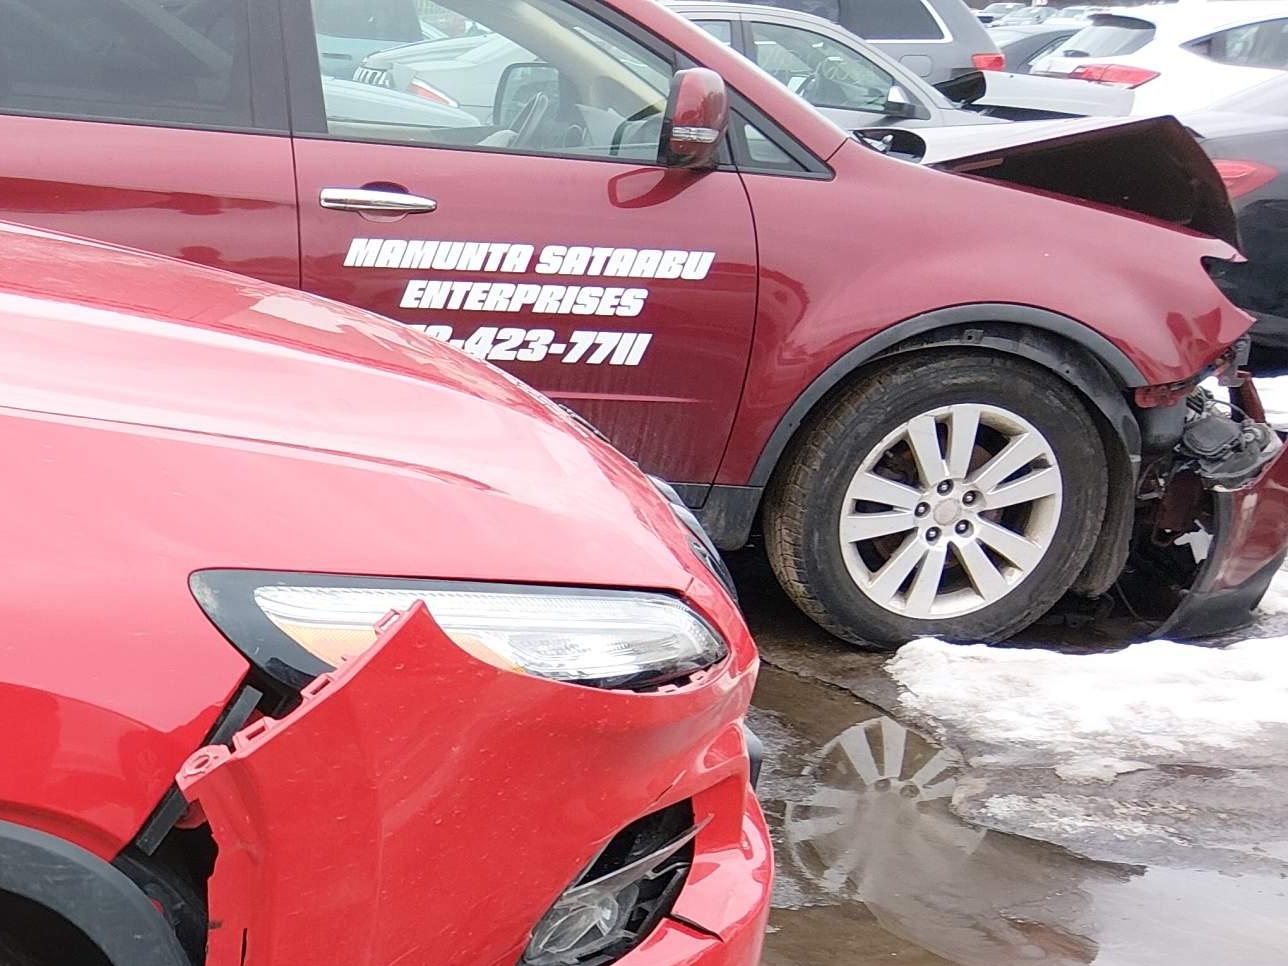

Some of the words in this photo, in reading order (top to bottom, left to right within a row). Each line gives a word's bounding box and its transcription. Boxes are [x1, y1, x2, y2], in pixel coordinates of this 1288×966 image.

[343, 238, 535, 273] MAMUNTA
[535, 245, 716, 280] SATAABU
[399, 280, 649, 317] ENTERPRISES
